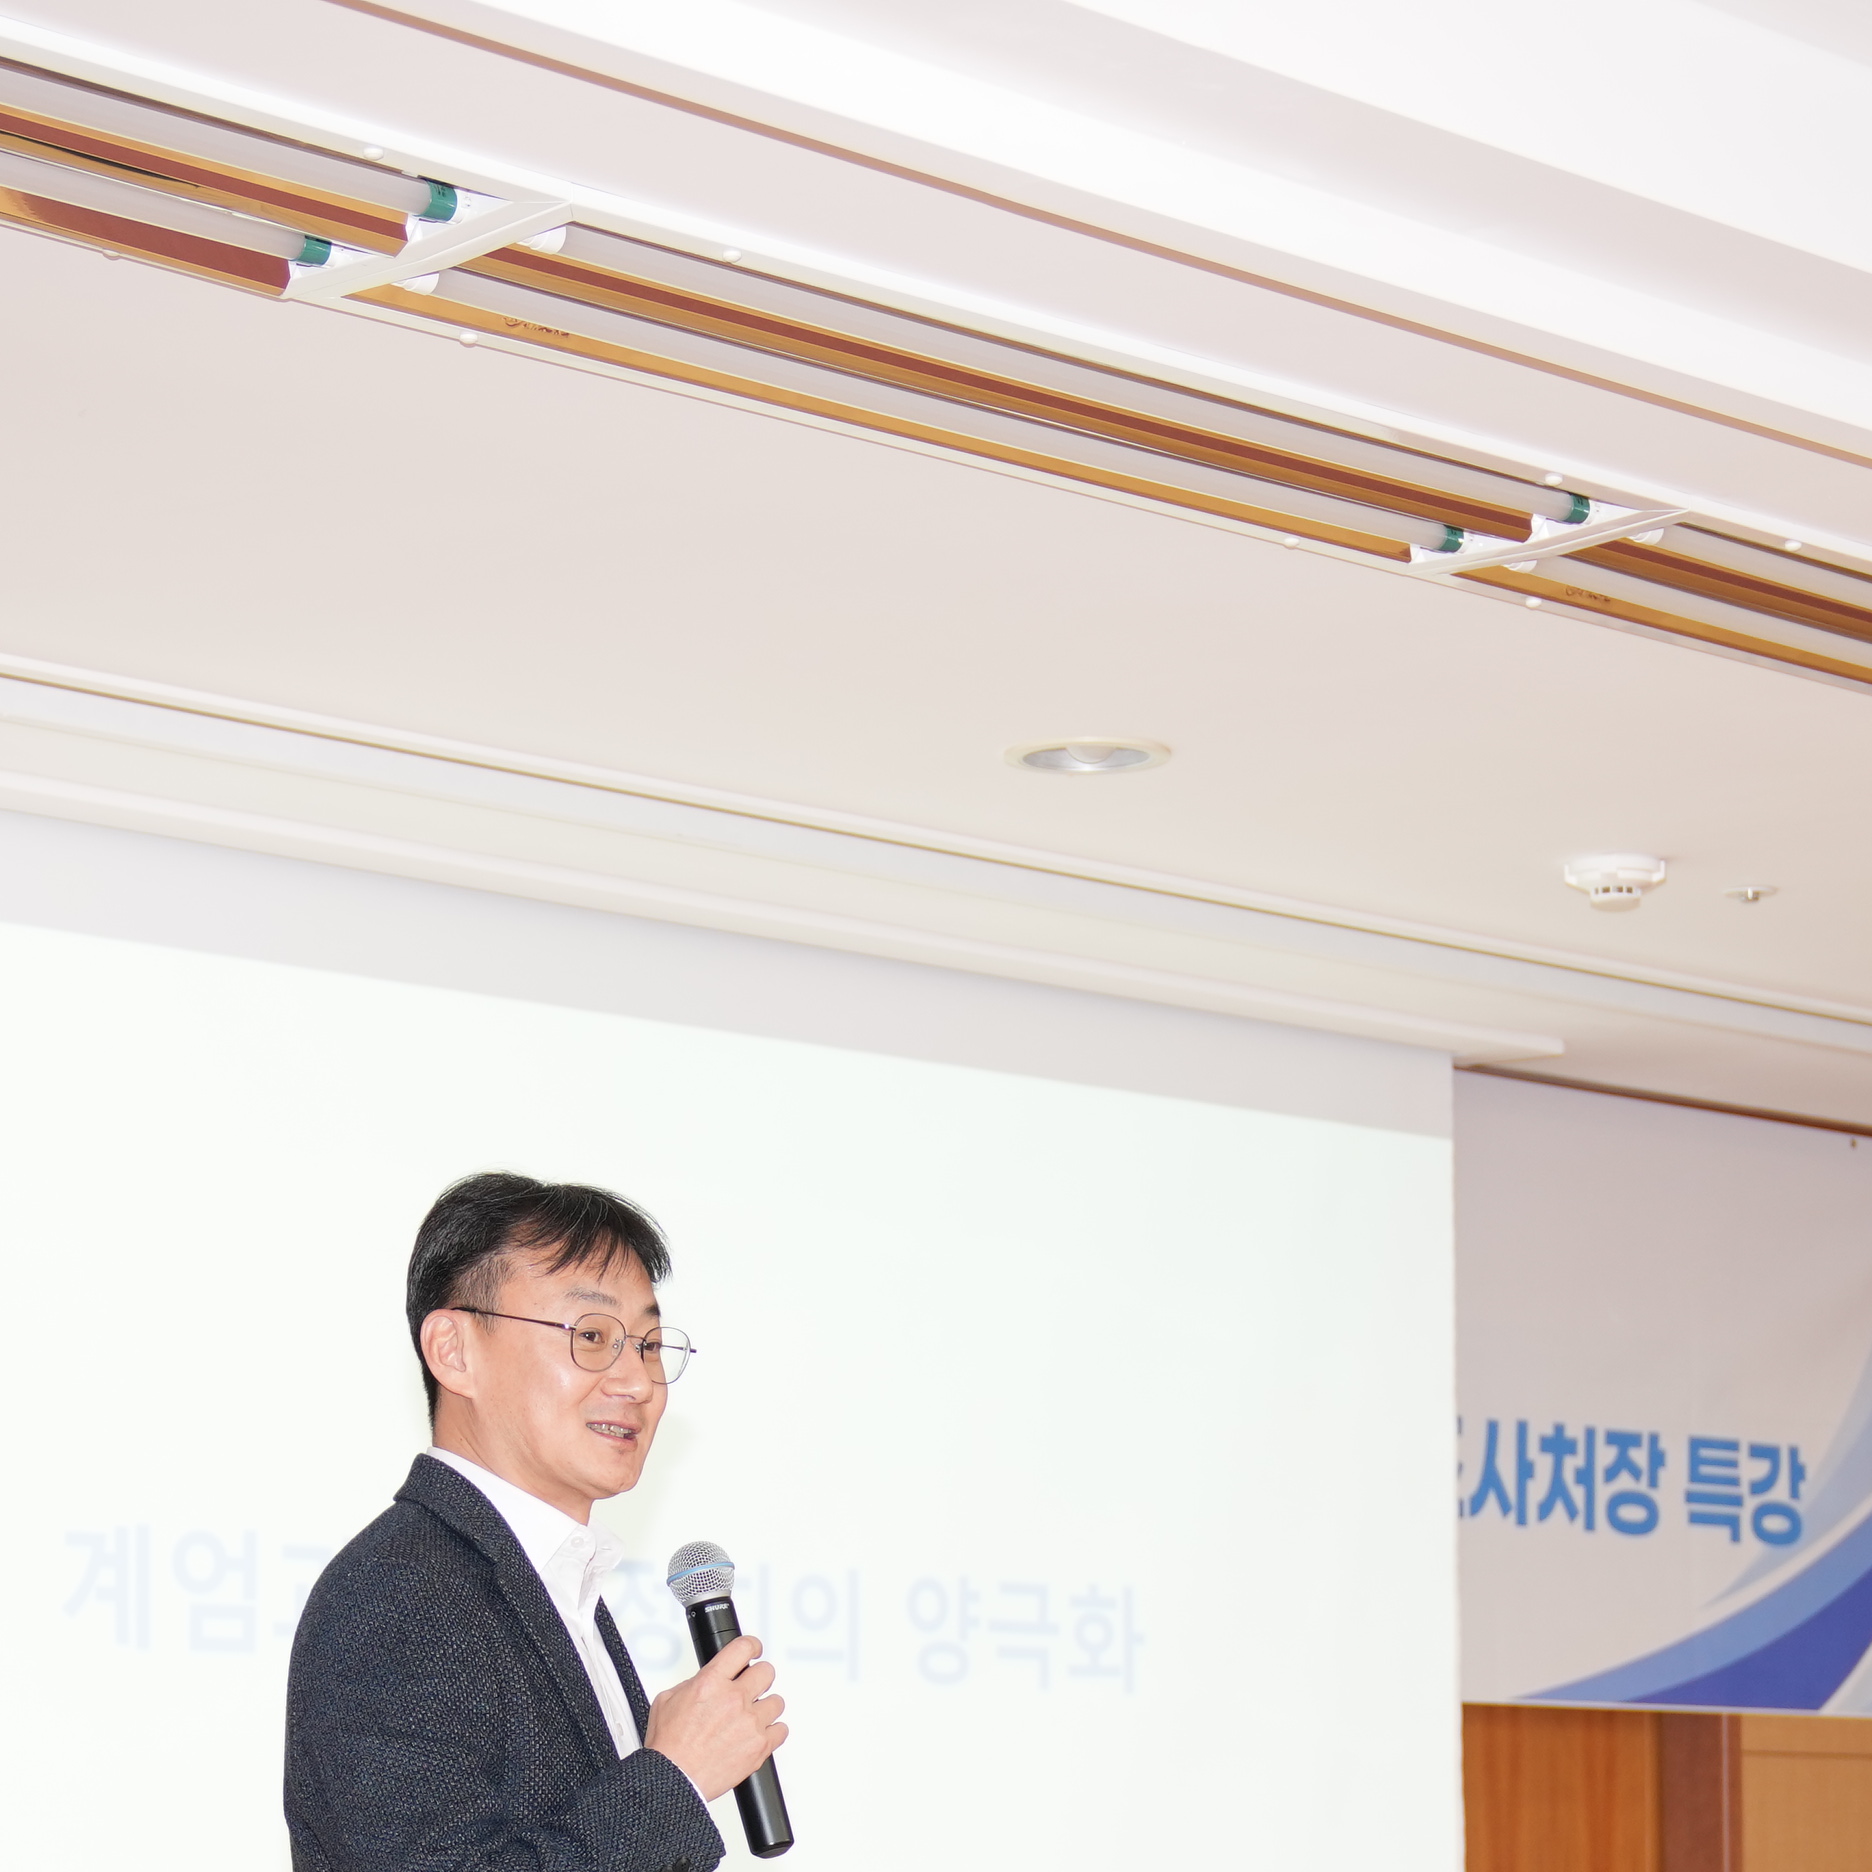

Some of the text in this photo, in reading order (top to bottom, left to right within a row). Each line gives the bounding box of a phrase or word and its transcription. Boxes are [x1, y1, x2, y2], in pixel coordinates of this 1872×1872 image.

[1457, 1415, 1807, 1546] 사처장 특강
[905, 1574, 1146, 1694] 양극화
